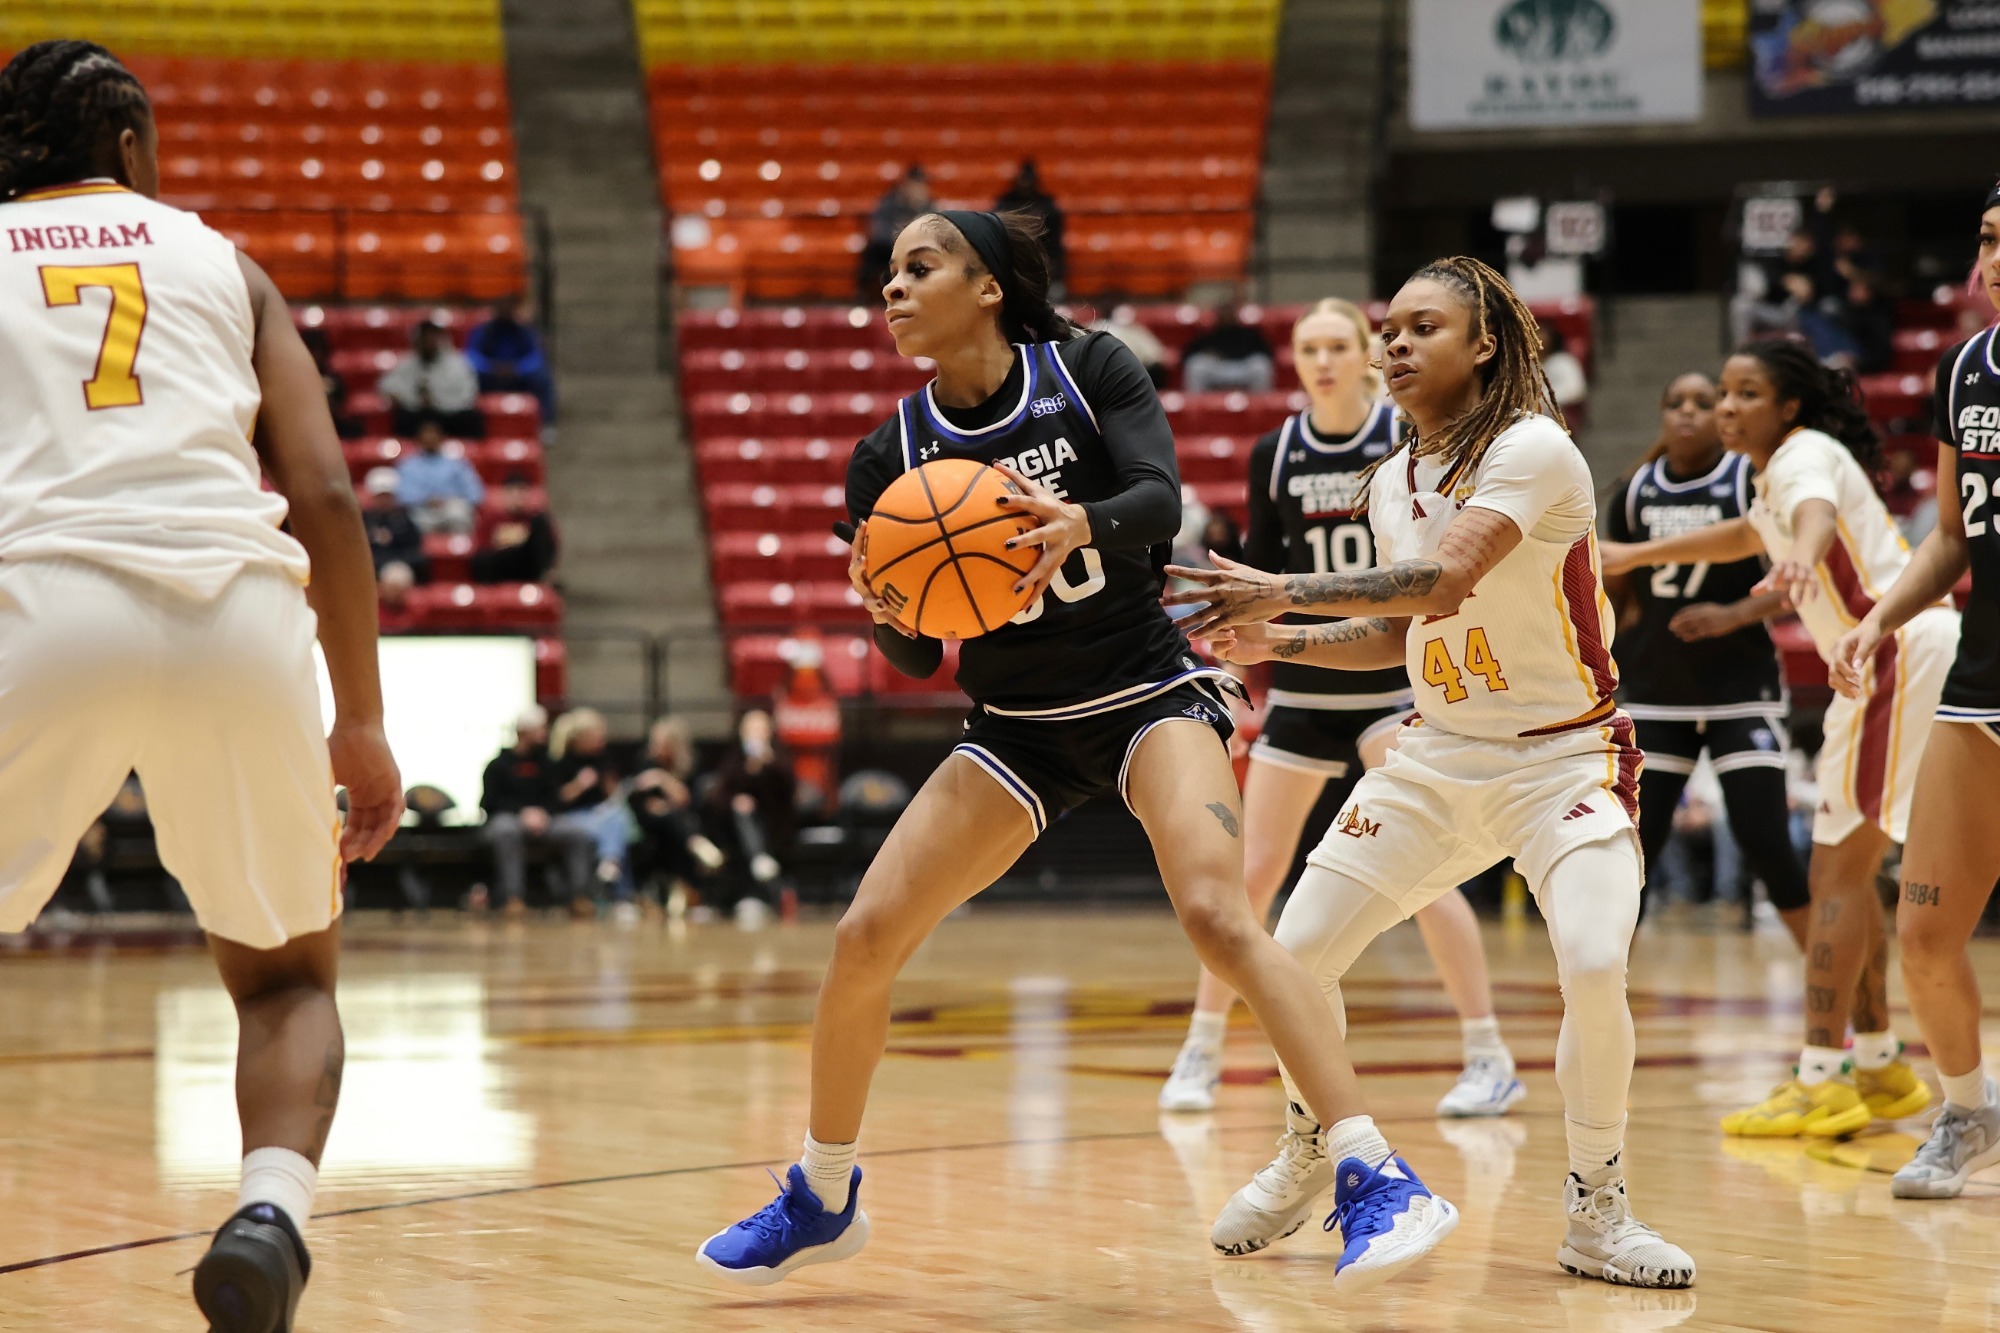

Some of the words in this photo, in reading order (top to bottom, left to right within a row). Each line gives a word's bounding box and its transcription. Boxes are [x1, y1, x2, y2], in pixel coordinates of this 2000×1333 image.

[7, 222, 155, 252] INGRAM
[37, 261, 149, 412] 7
[1029, 392, 1067, 418] SBC
[1958, 404, 2000, 430] GEO
[995, 437, 1079, 478] RGIA
[1287, 470, 1368, 497] GEORG
[1304, 523, 1372, 573] 10
[1422, 626, 1509, 705] 44
[1905, 881, 1941, 906] 1984
